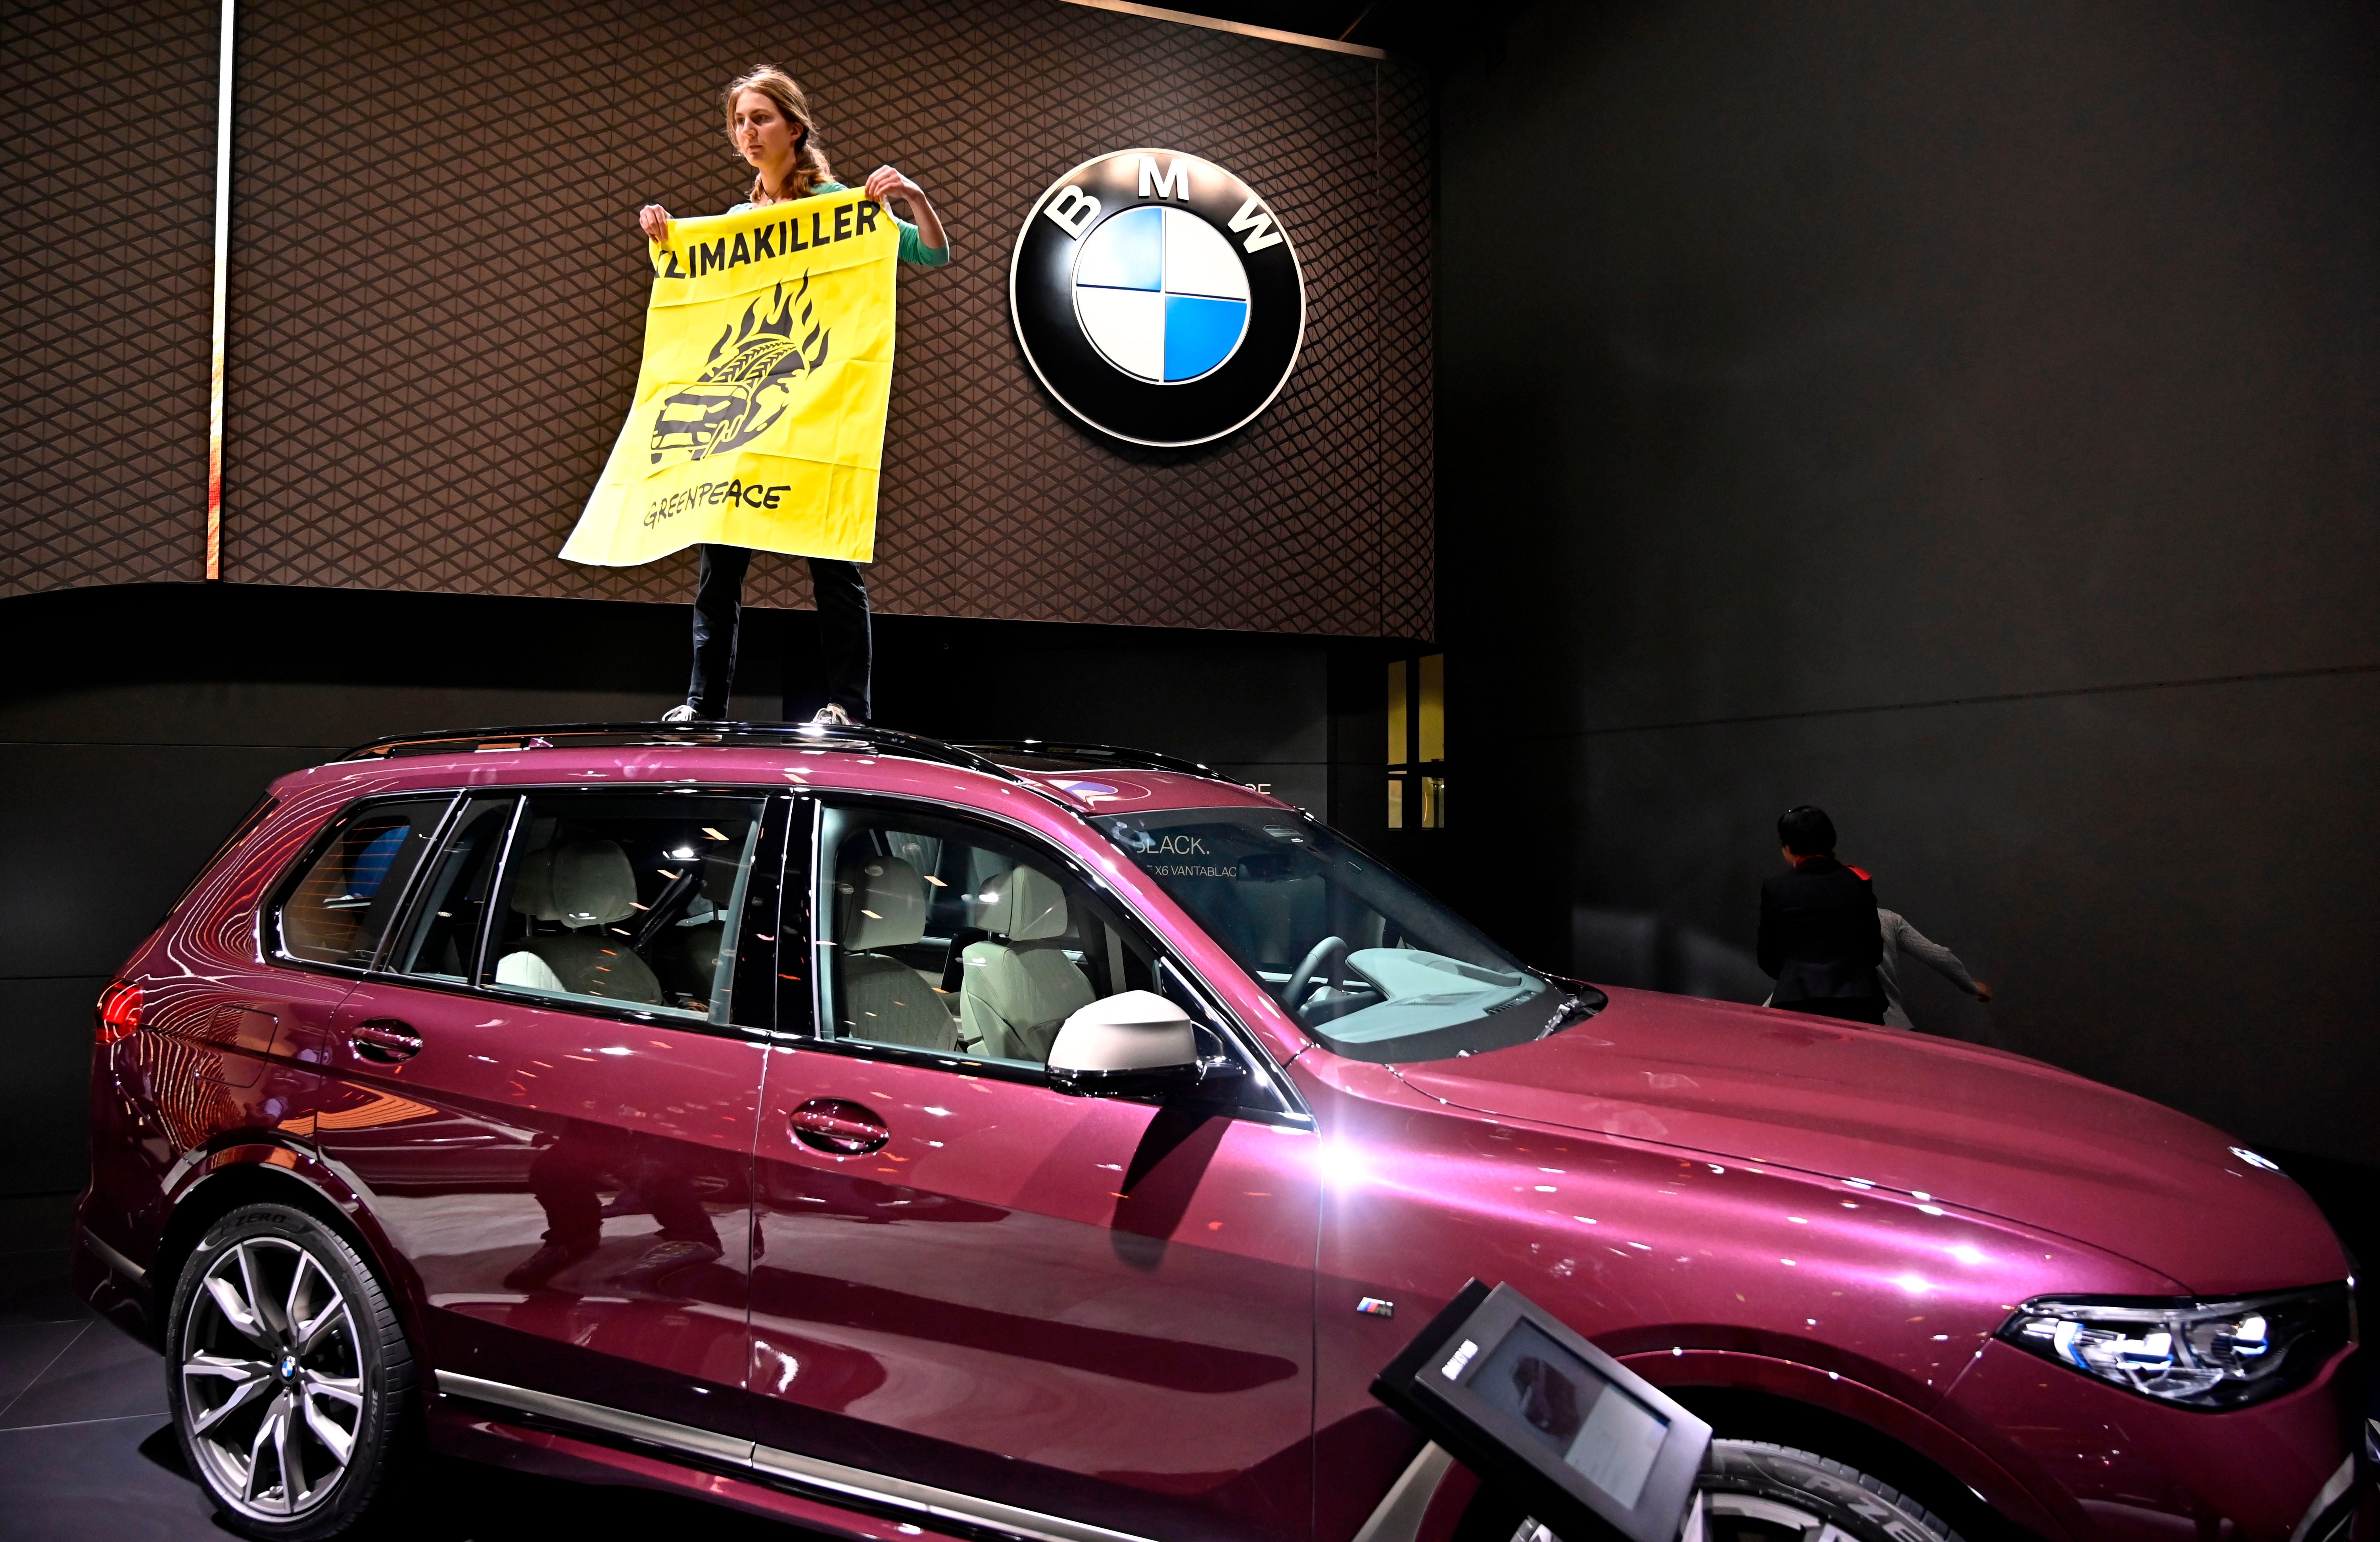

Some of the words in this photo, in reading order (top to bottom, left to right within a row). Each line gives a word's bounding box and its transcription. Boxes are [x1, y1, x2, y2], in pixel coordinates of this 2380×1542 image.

[1043, 156, 1283, 254] BMW
[643, 479, 791, 529] GREENPEACE
[1155, 865, 1169, 876] X6
[235, 1212, 287, 1227] ZERO
